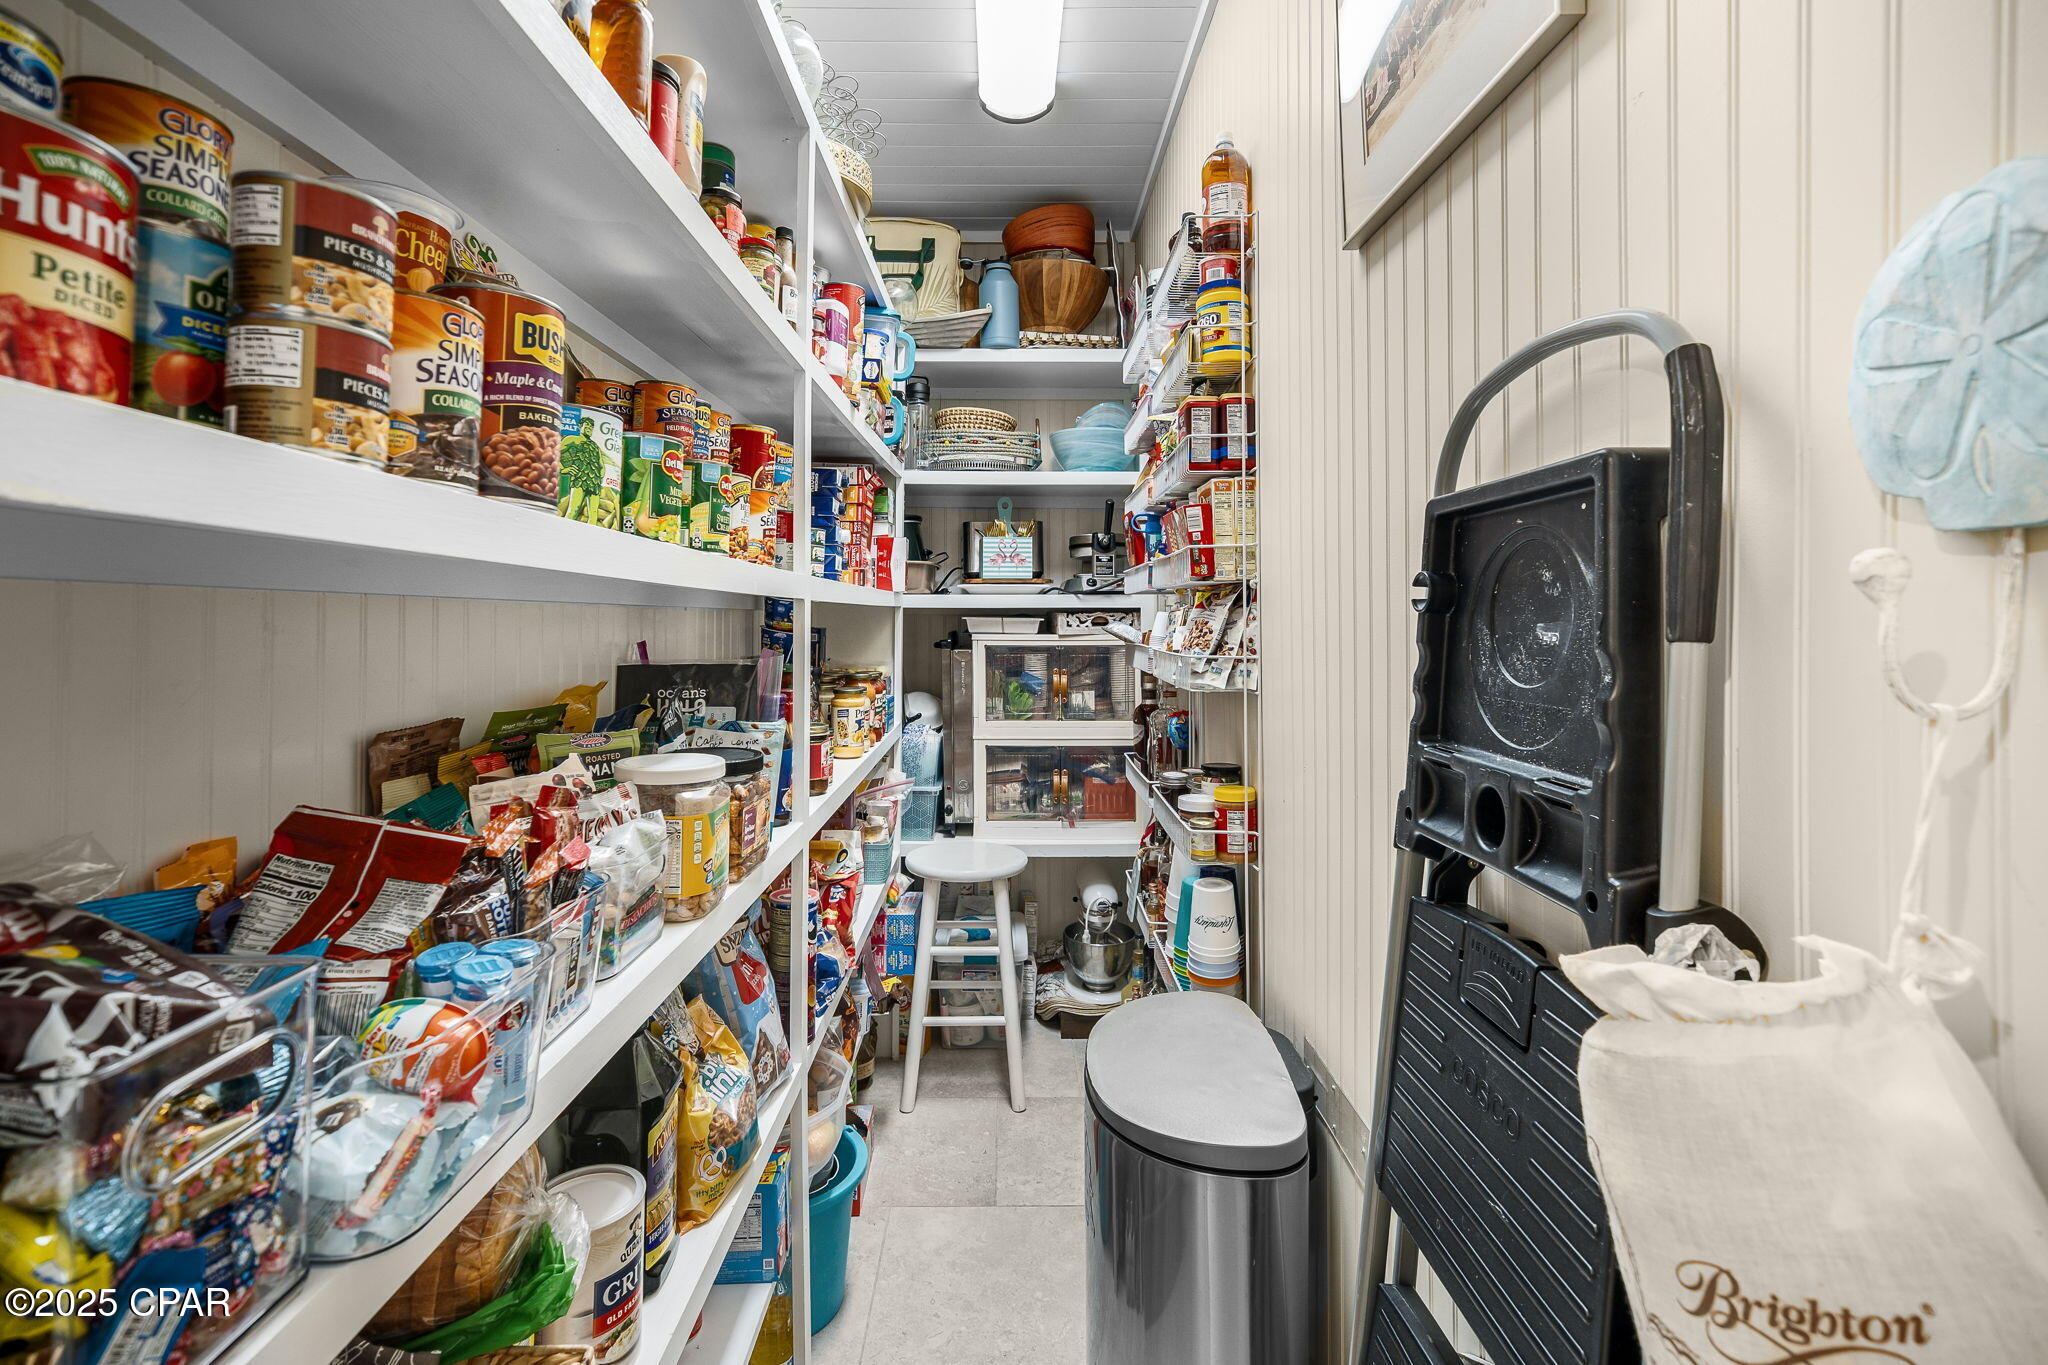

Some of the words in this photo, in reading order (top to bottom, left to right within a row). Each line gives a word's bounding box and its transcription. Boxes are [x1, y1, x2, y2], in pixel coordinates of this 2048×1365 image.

[323, 234, 375, 264] PIECES
[31, 250, 127, 309] Petite
[54, 288, 115, 320] DICED
[343, 377, 383, 400] PIECES
[494, 372, 535, 389] Maple
[536, 375, 546, 389] &
[604, 386, 633, 402] GLO
[518, 411, 554, 425] BAKED
[585, 752, 621, 764] ROASTED
[274, 855, 311, 870] Nutrition
[311, 863, 332, 874] Facts
[255, 881, 293, 897] Calories
[294, 889, 317, 901] 100
[1676, 1260, 1931, 1345] Brighton
[606, 1309, 624, 1326] OLD
